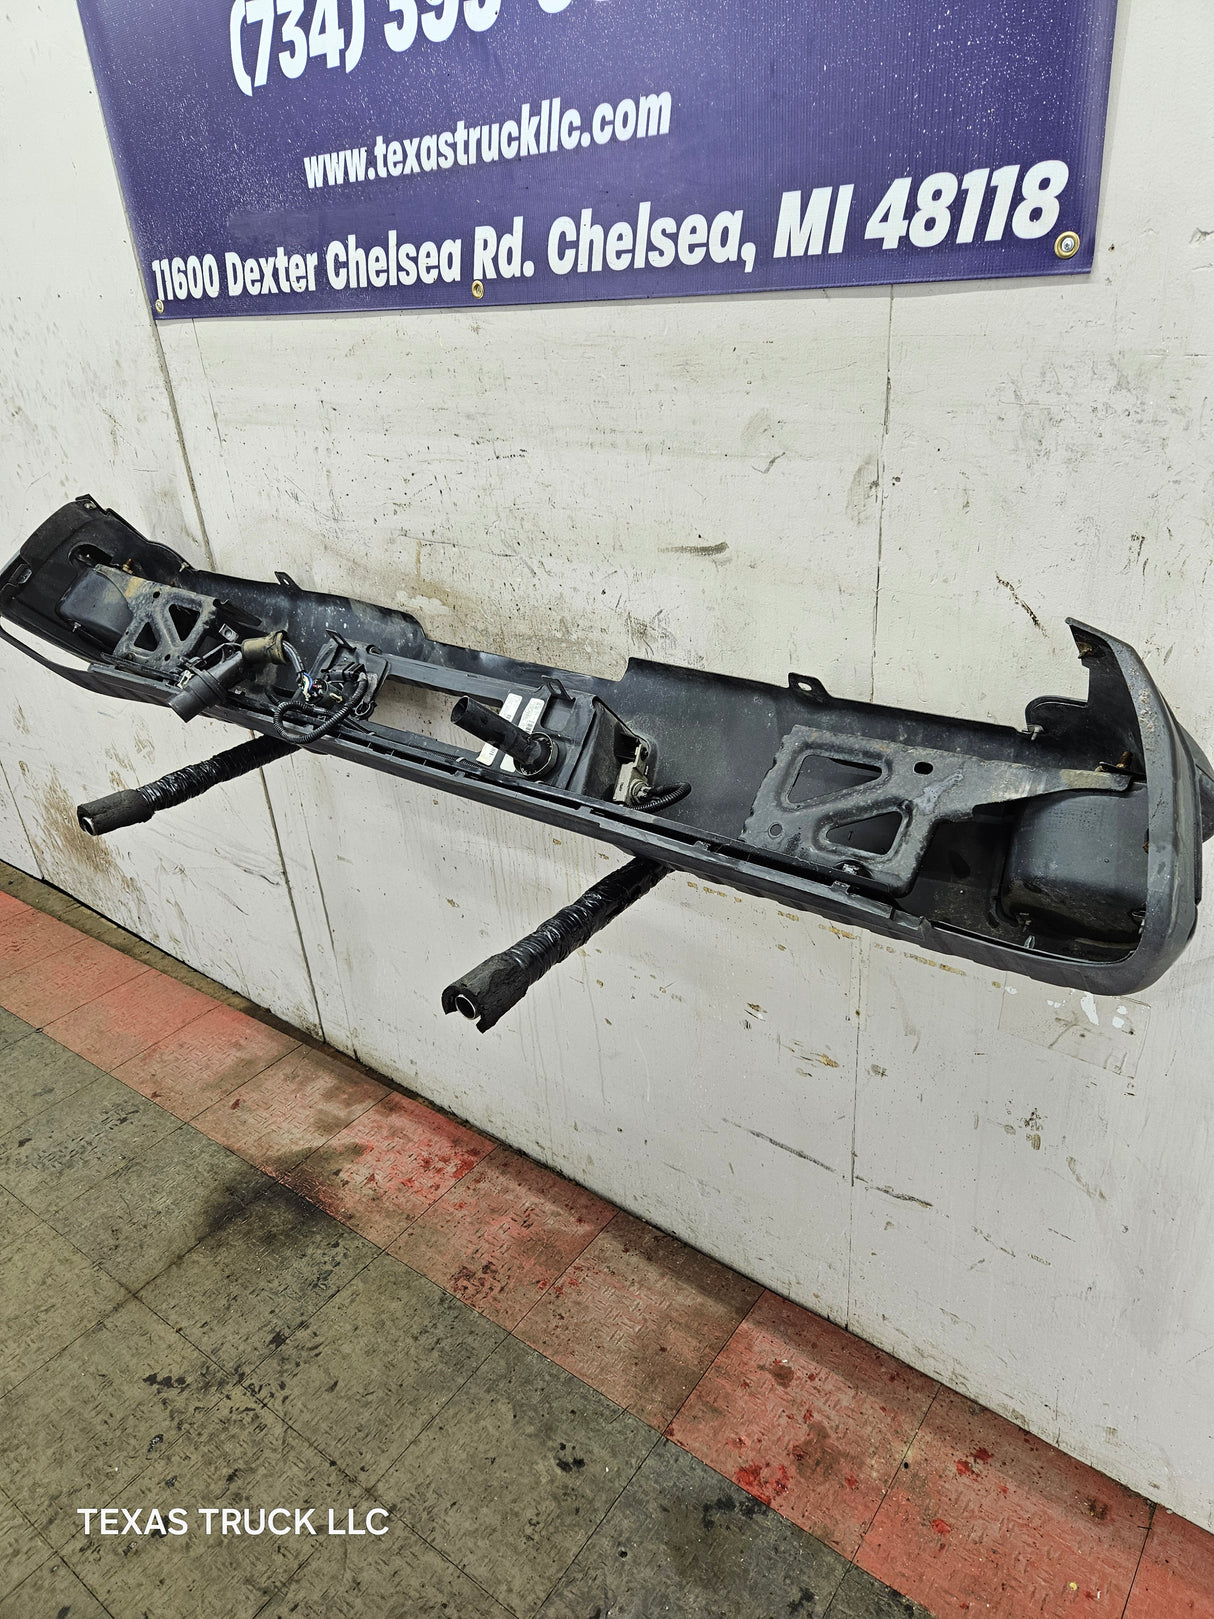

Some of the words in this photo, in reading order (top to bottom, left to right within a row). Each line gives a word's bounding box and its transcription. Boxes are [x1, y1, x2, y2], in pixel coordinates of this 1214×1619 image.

[230, 0, 366, 97] (734)
[303, 91, 672, 189] www.texastruckllc.com
[152, 254, 220, 301] 11600
[225, 246, 318, 297] Dexter
[326, 230, 461, 290] Chelsea
[473, 215, 535, 281] Rd.
[547, 201, 757, 277] Chelsea,
[774, 183, 855, 260] MI
[864, 159, 1069, 254] 48118
